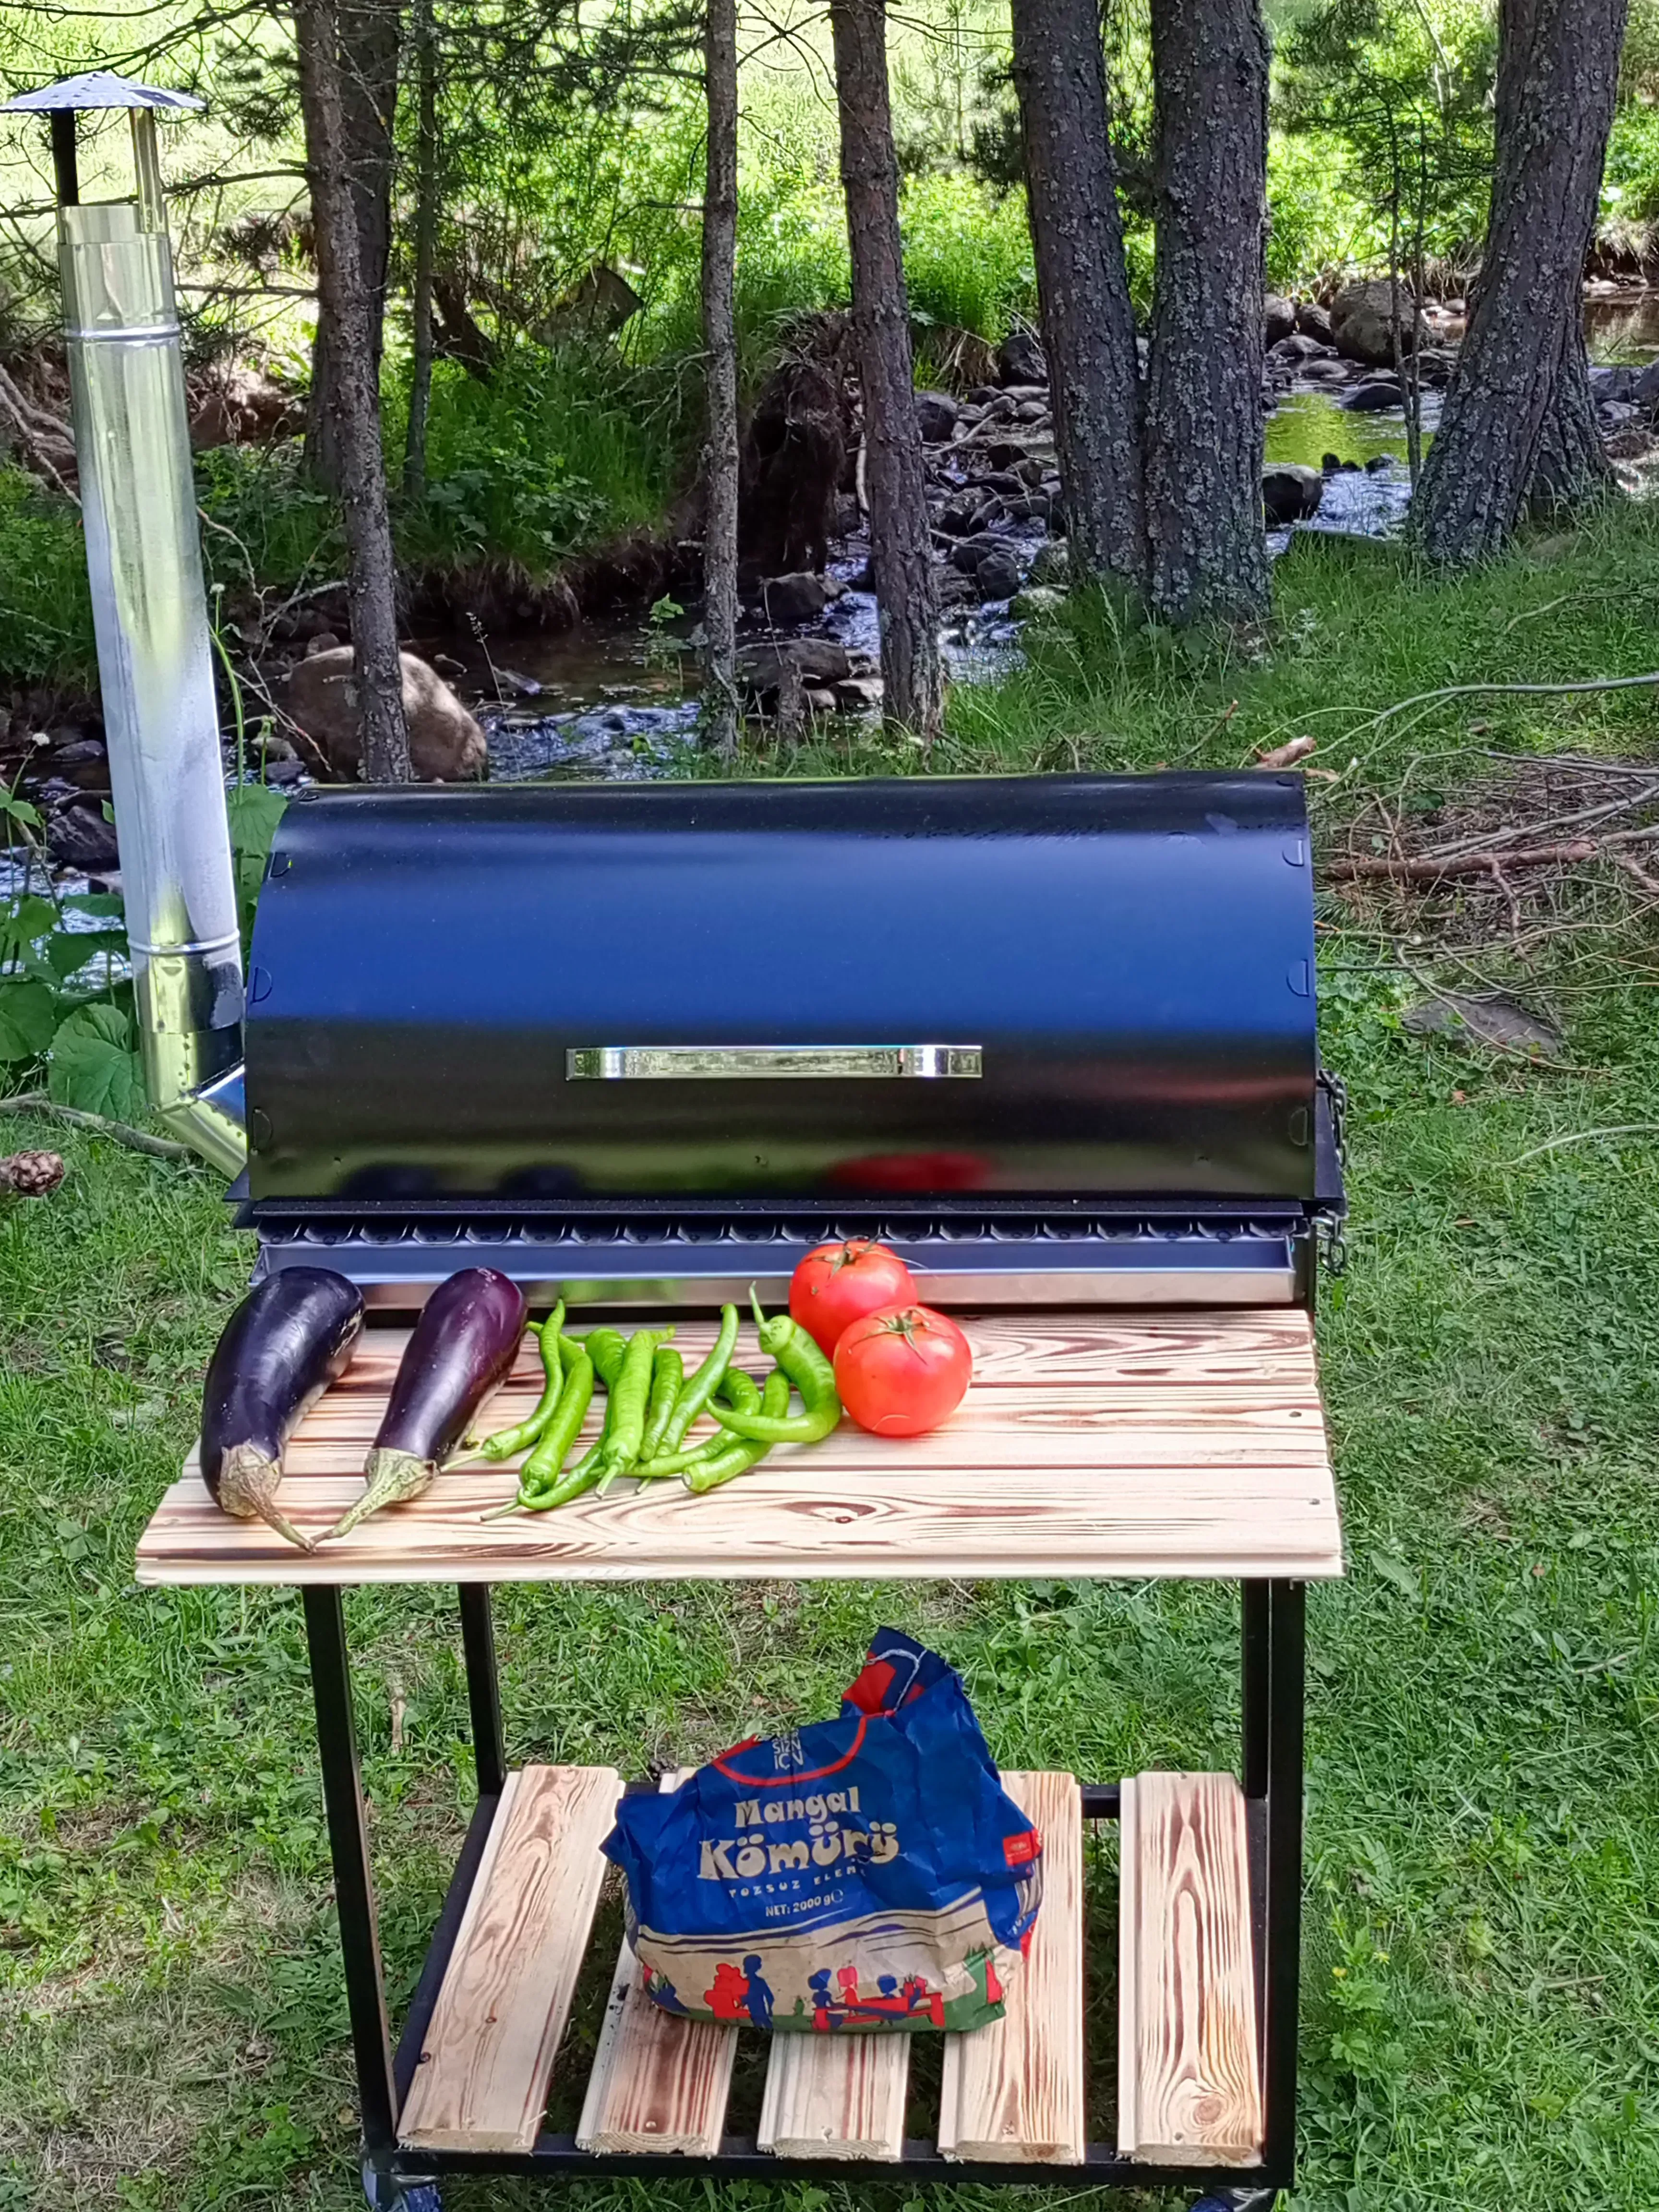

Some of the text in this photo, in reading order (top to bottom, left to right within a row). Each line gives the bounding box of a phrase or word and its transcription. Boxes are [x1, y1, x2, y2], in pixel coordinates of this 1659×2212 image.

[733, 1786, 861, 1828] Mangal
[697, 1821, 899, 1880] Kömürü
[729, 1880, 800, 1898] TOZSUZ
[765, 1904, 790, 1917] NET:
[793, 1896, 821, 1913] 2000
